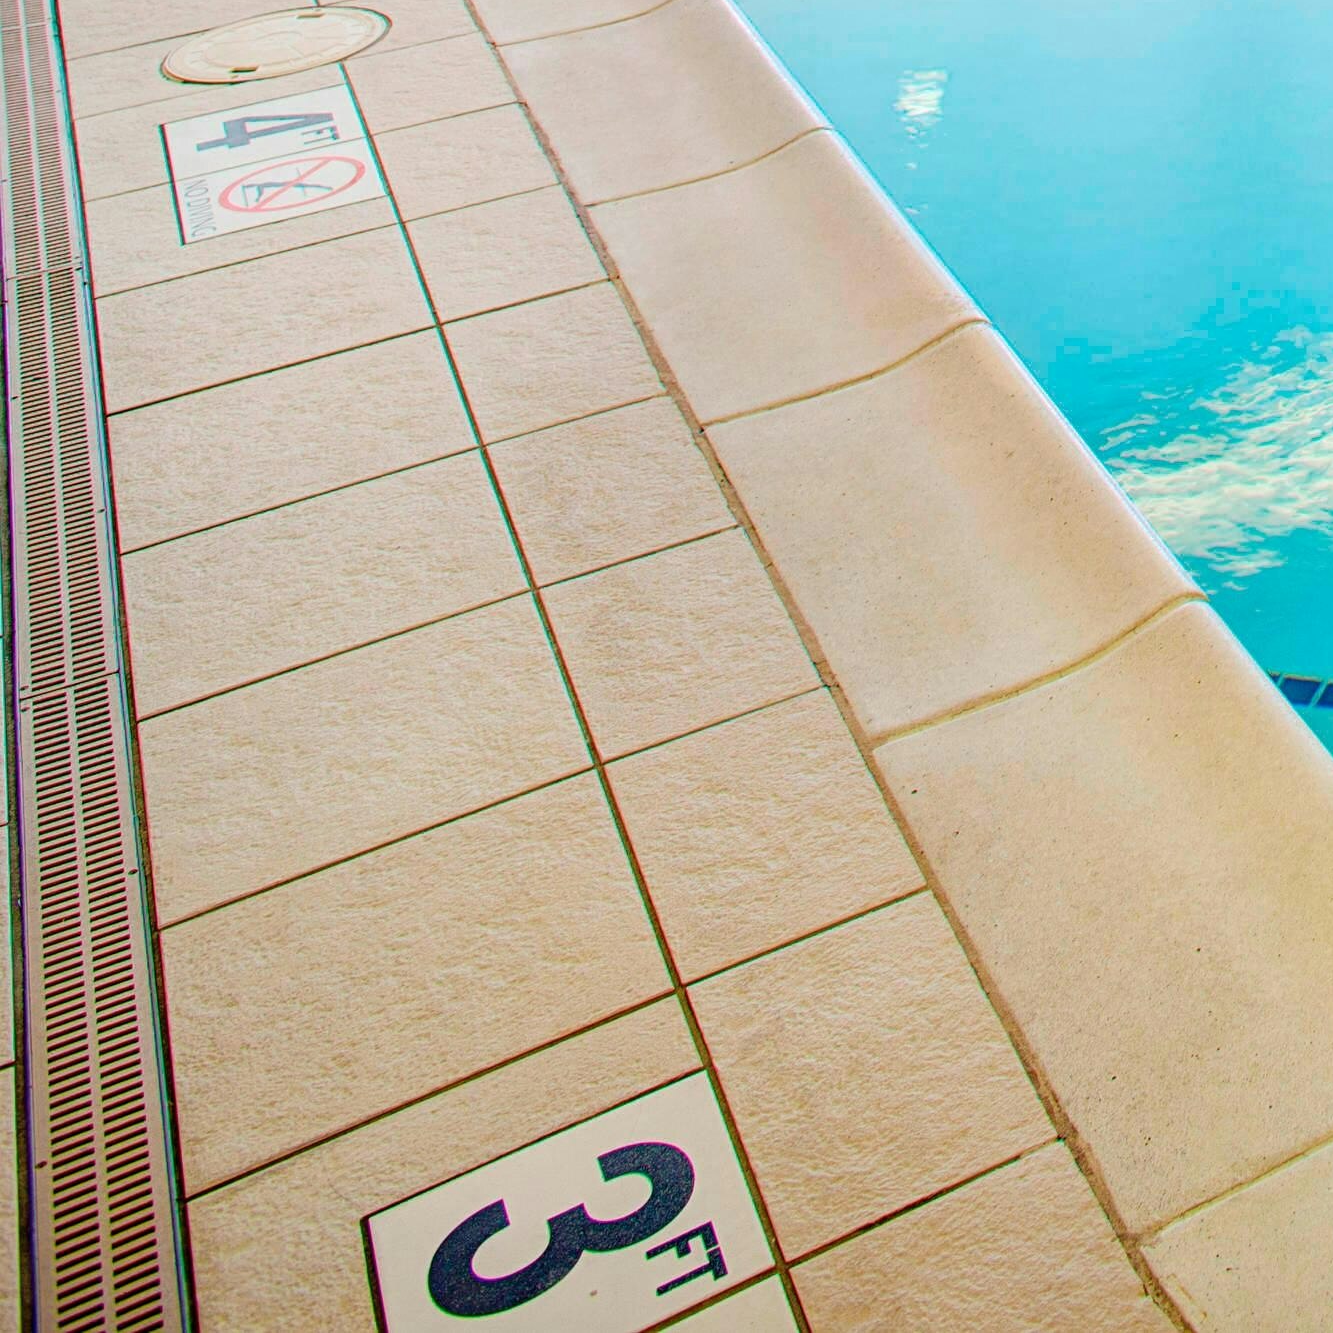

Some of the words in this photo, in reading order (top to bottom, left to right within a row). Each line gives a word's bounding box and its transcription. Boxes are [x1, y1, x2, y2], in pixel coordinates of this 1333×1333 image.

[196, 112, 334, 152] 4
[301, 125, 341, 145] FT
[184, 178, 209, 197] NO
[187, 197, 217, 238] DIVING
[427, 1141, 696, 1317] 3
[645, 1220, 729, 1297] FT
